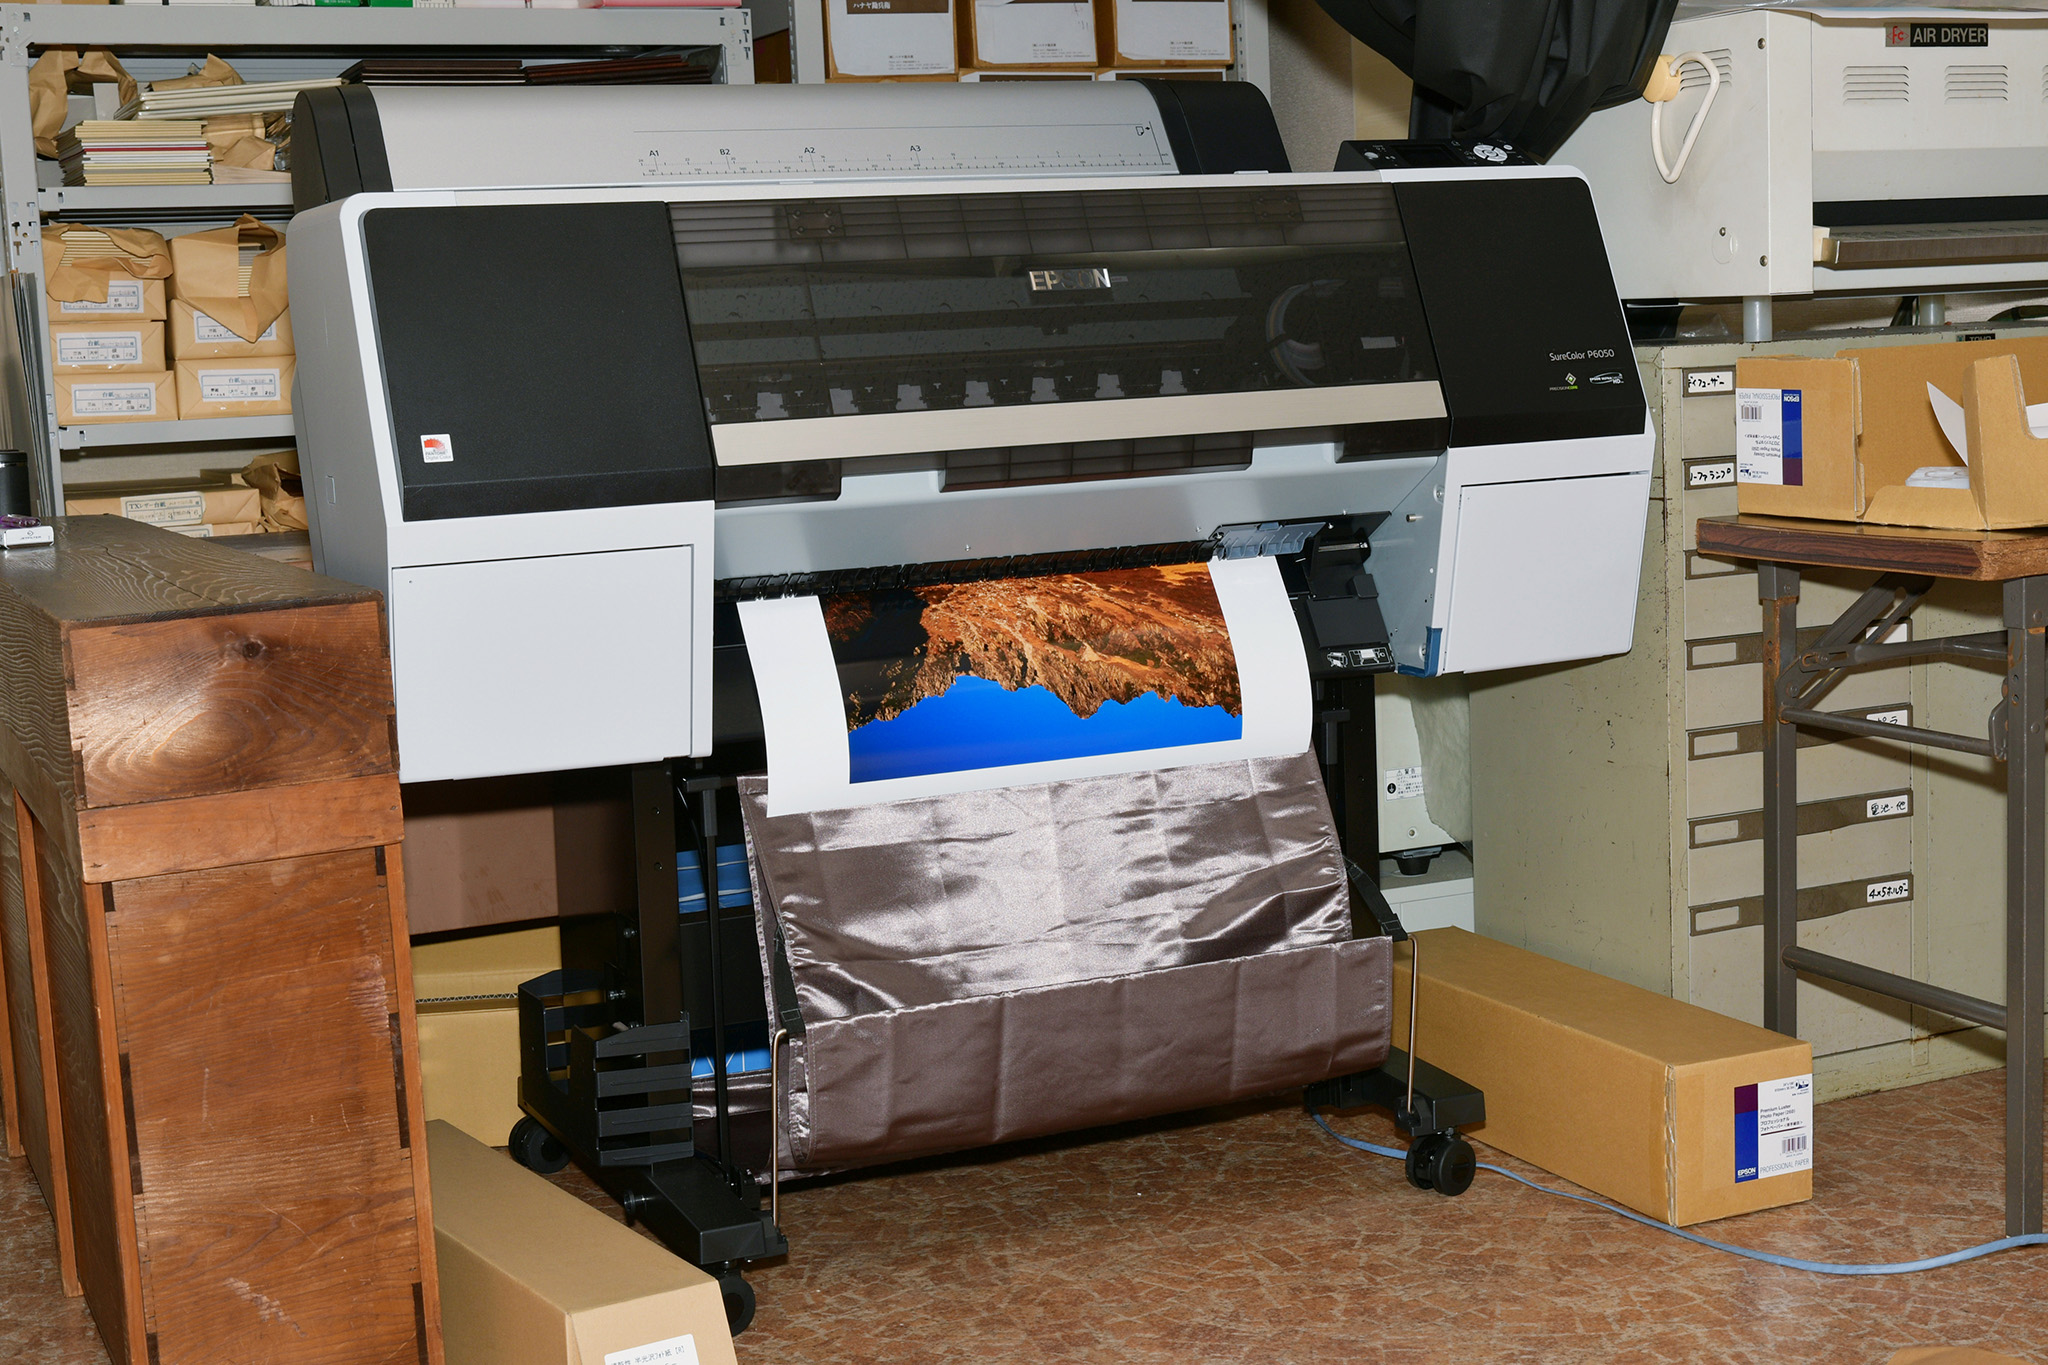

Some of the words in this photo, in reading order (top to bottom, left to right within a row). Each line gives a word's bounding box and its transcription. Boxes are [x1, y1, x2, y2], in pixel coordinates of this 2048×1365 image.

[1913, 27, 1937, 43] AIR
[1941, 27, 1987, 43] DRYER
[649, 149, 660, 157] A1
[720, 148, 731, 156] B2
[804, 146, 816, 154] A2
[1029, 268, 1111, 291] EPSON
[1549, 351, 1586, 361] SureColor
[1587, 349, 1615, 359] P6050
[1752, 392, 1780, 400] PROFESSIONAL
[1760, 1161, 1794, 1173] PROFESSIONAL
[1795, 1158, 1809, 1167] PAPER
[1738, 1167, 1756, 1176] EPSON
